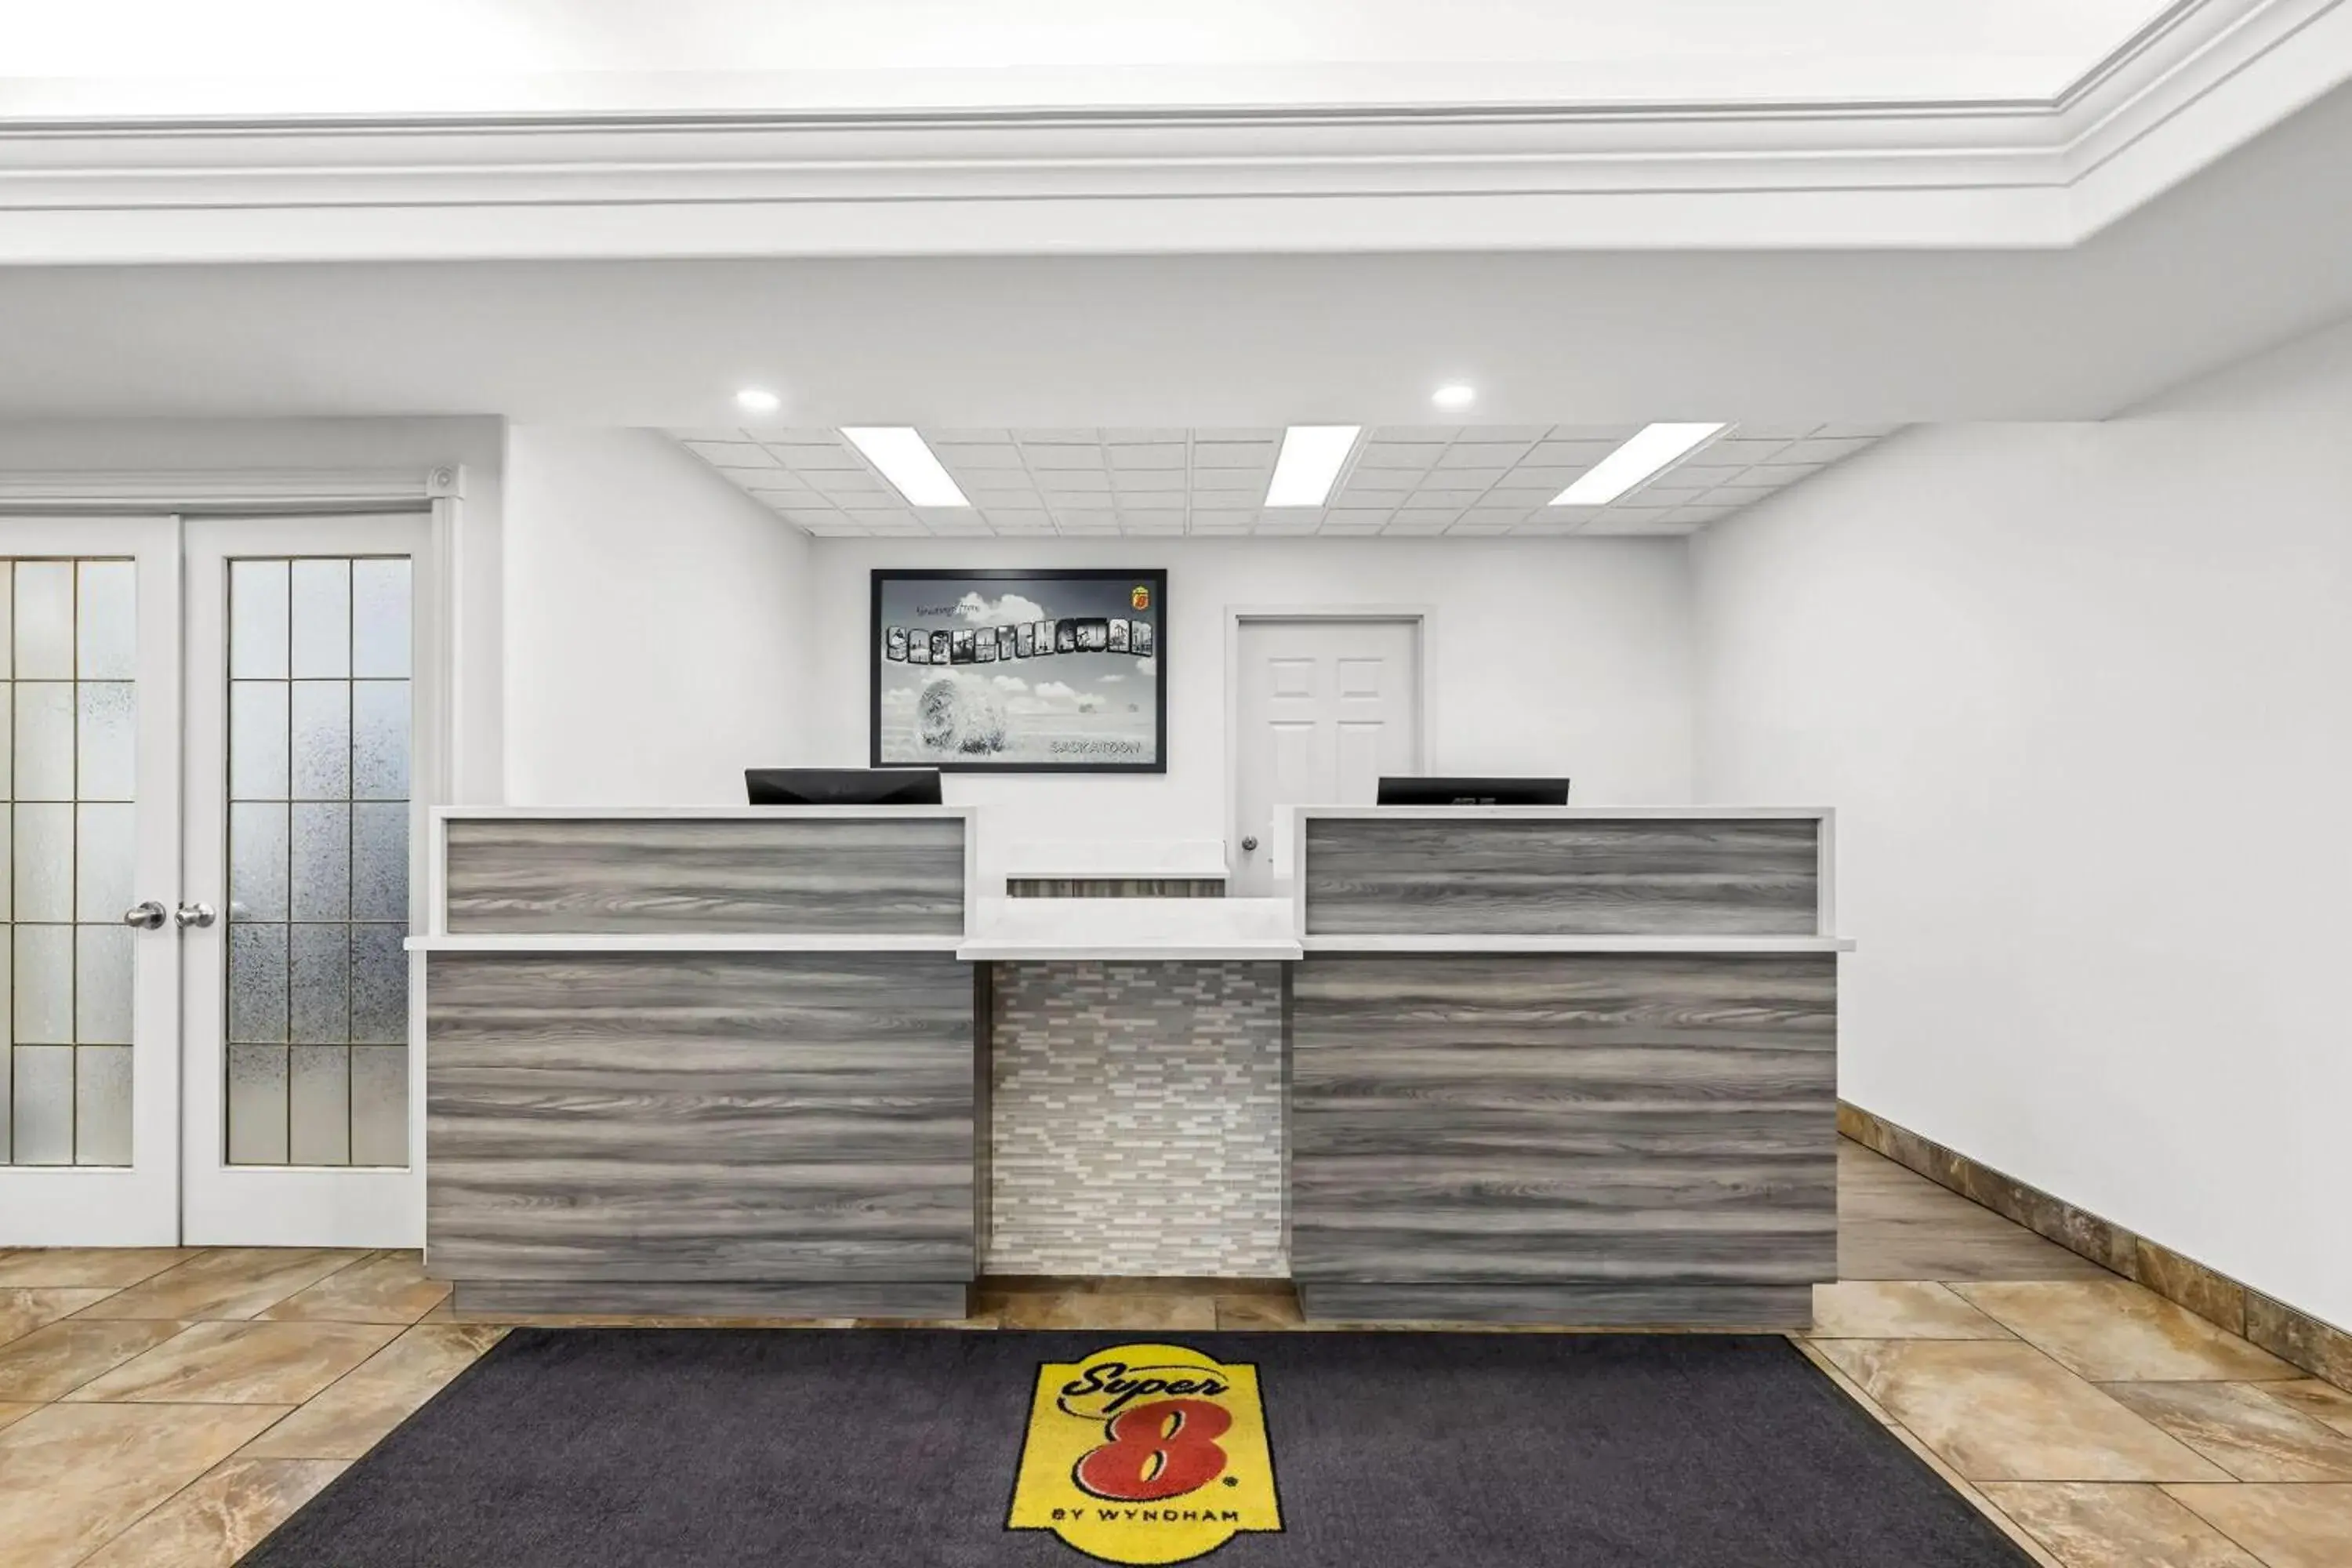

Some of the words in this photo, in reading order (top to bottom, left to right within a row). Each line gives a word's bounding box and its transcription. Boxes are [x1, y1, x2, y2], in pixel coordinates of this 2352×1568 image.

[886, 617, 1153, 665] SASKATCHEWAN
[1059, 1362, 1229, 1414] Super
[1071, 1398, 1233, 1502] 8
[1051, 1508, 1084, 1521] BY
[1097, 1508, 1240, 1522] WYNDHAM
